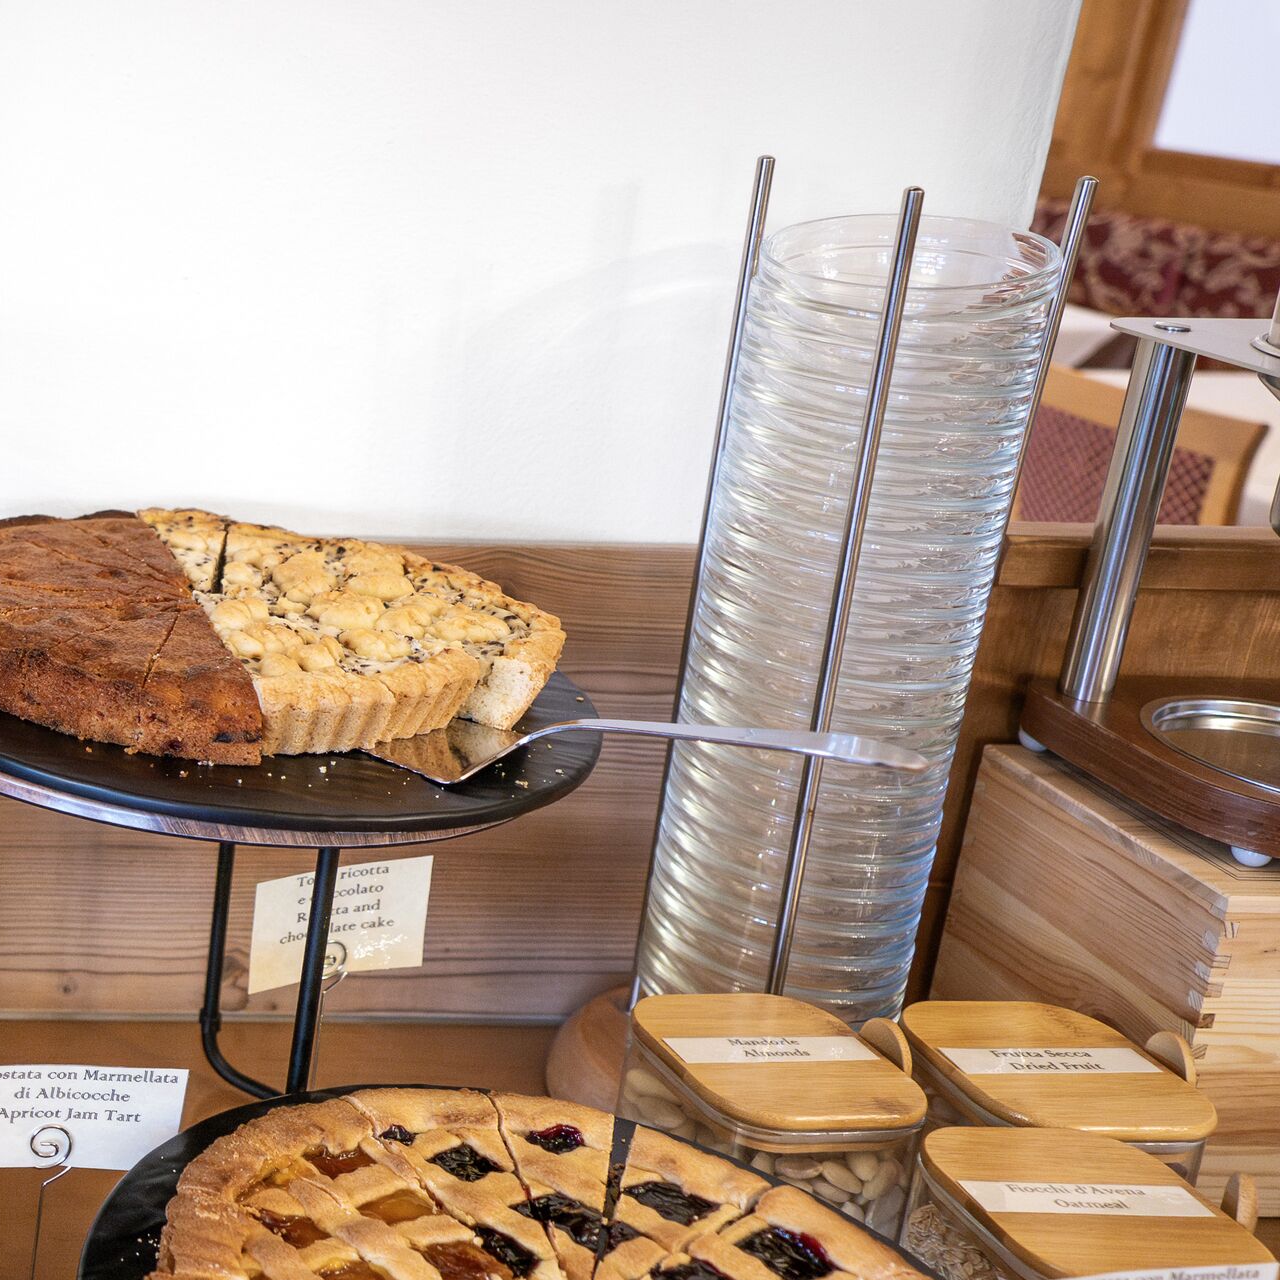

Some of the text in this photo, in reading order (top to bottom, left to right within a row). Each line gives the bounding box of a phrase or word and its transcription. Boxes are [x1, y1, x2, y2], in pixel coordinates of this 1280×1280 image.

[340, 866, 390, 879] ricotta
[310, 883, 384, 902] ccolato
[353, 898, 381, 912] and
[280, 916, 395, 945] cholate cake
[743, 1048, 811, 1058] Almonds
[1045, 1049, 1093, 1059] Secca
[1009, 1061, 1105, 1072] Dried Fruit
[47, 1071, 78, 1081] con
[83, 1069, 179, 1084] Marmellata
[14, 1087, 131, 1102] di Albicocche
[64, 1108, 99, 1122] Jam
[105, 1109, 142, 1123] Tart
[1005, 1183, 1071, 1195] Fiocchi
[1054, 1198, 1129, 1210] Oatmeal
